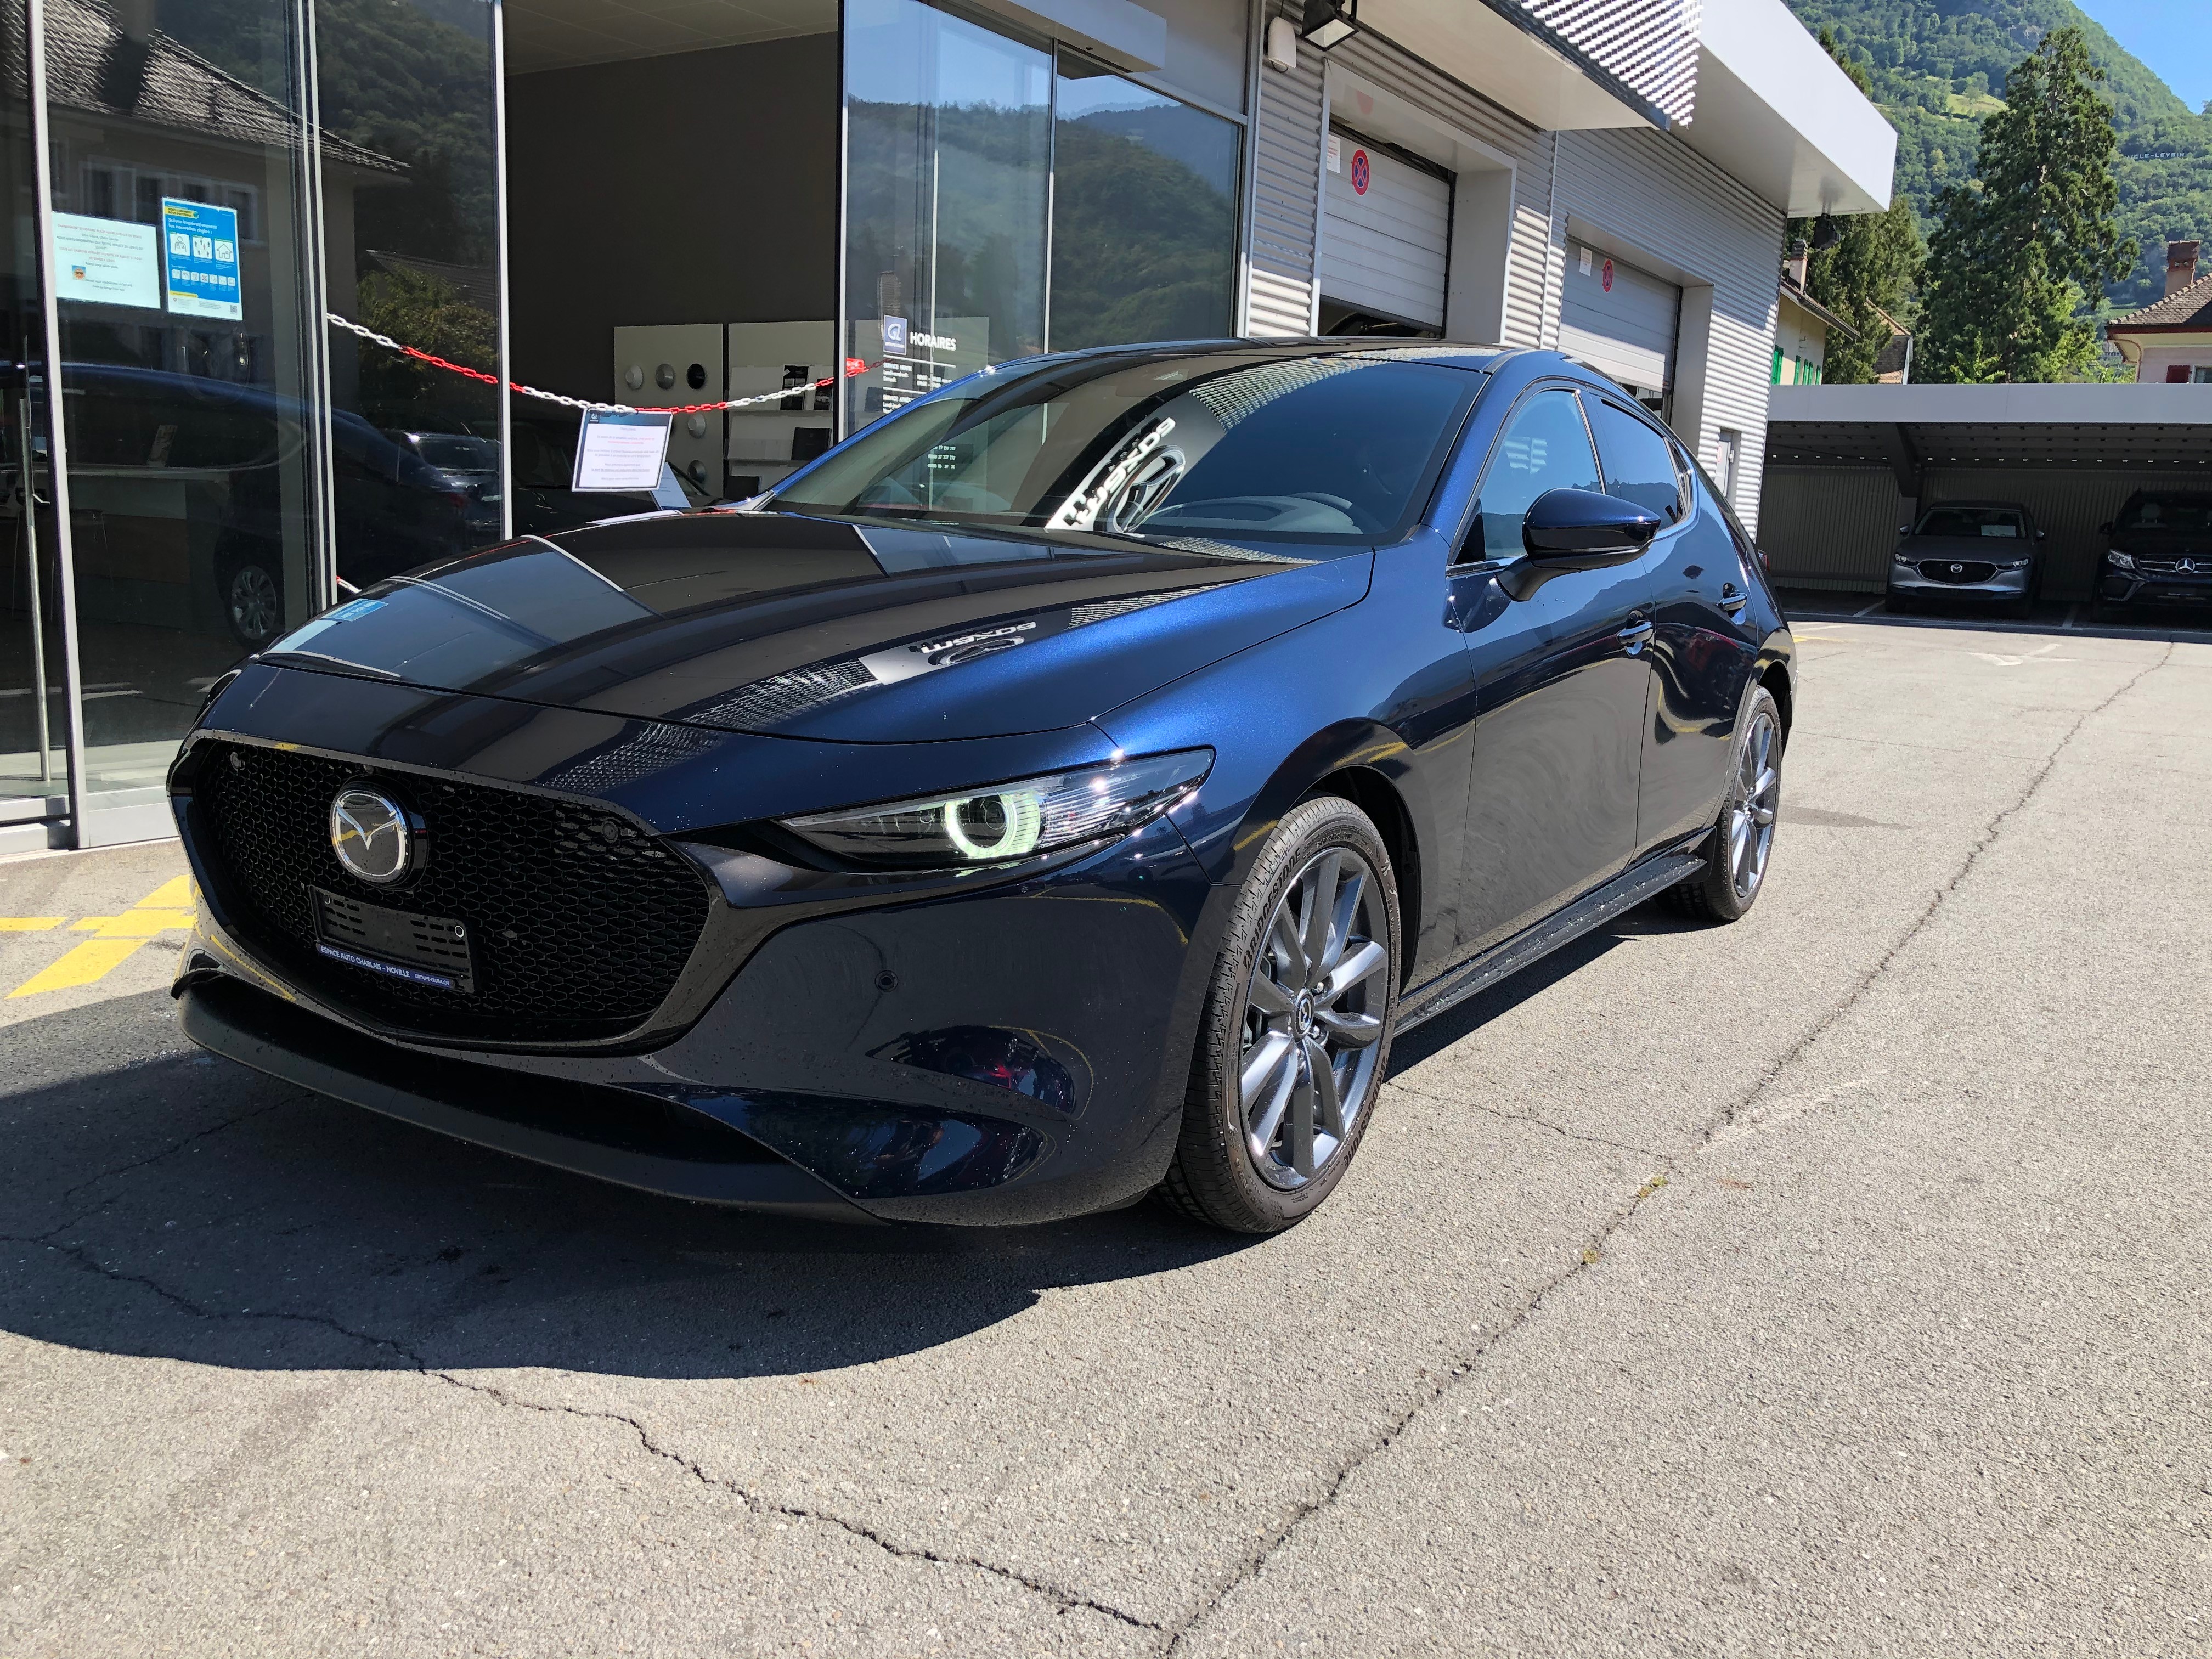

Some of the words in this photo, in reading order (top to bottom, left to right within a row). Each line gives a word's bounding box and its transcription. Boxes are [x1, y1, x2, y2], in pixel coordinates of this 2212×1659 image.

[910, 331, 957, 352] HORAIRES
[1243, 847, 1300, 973] BRIDGESTONE
[321, 946, 340, 958] ESPACE
[341, 952, 356, 963] AUTO
[356, 957, 382, 970] CHABLAIS
[386, 966, 411, 978] NOVILLE
